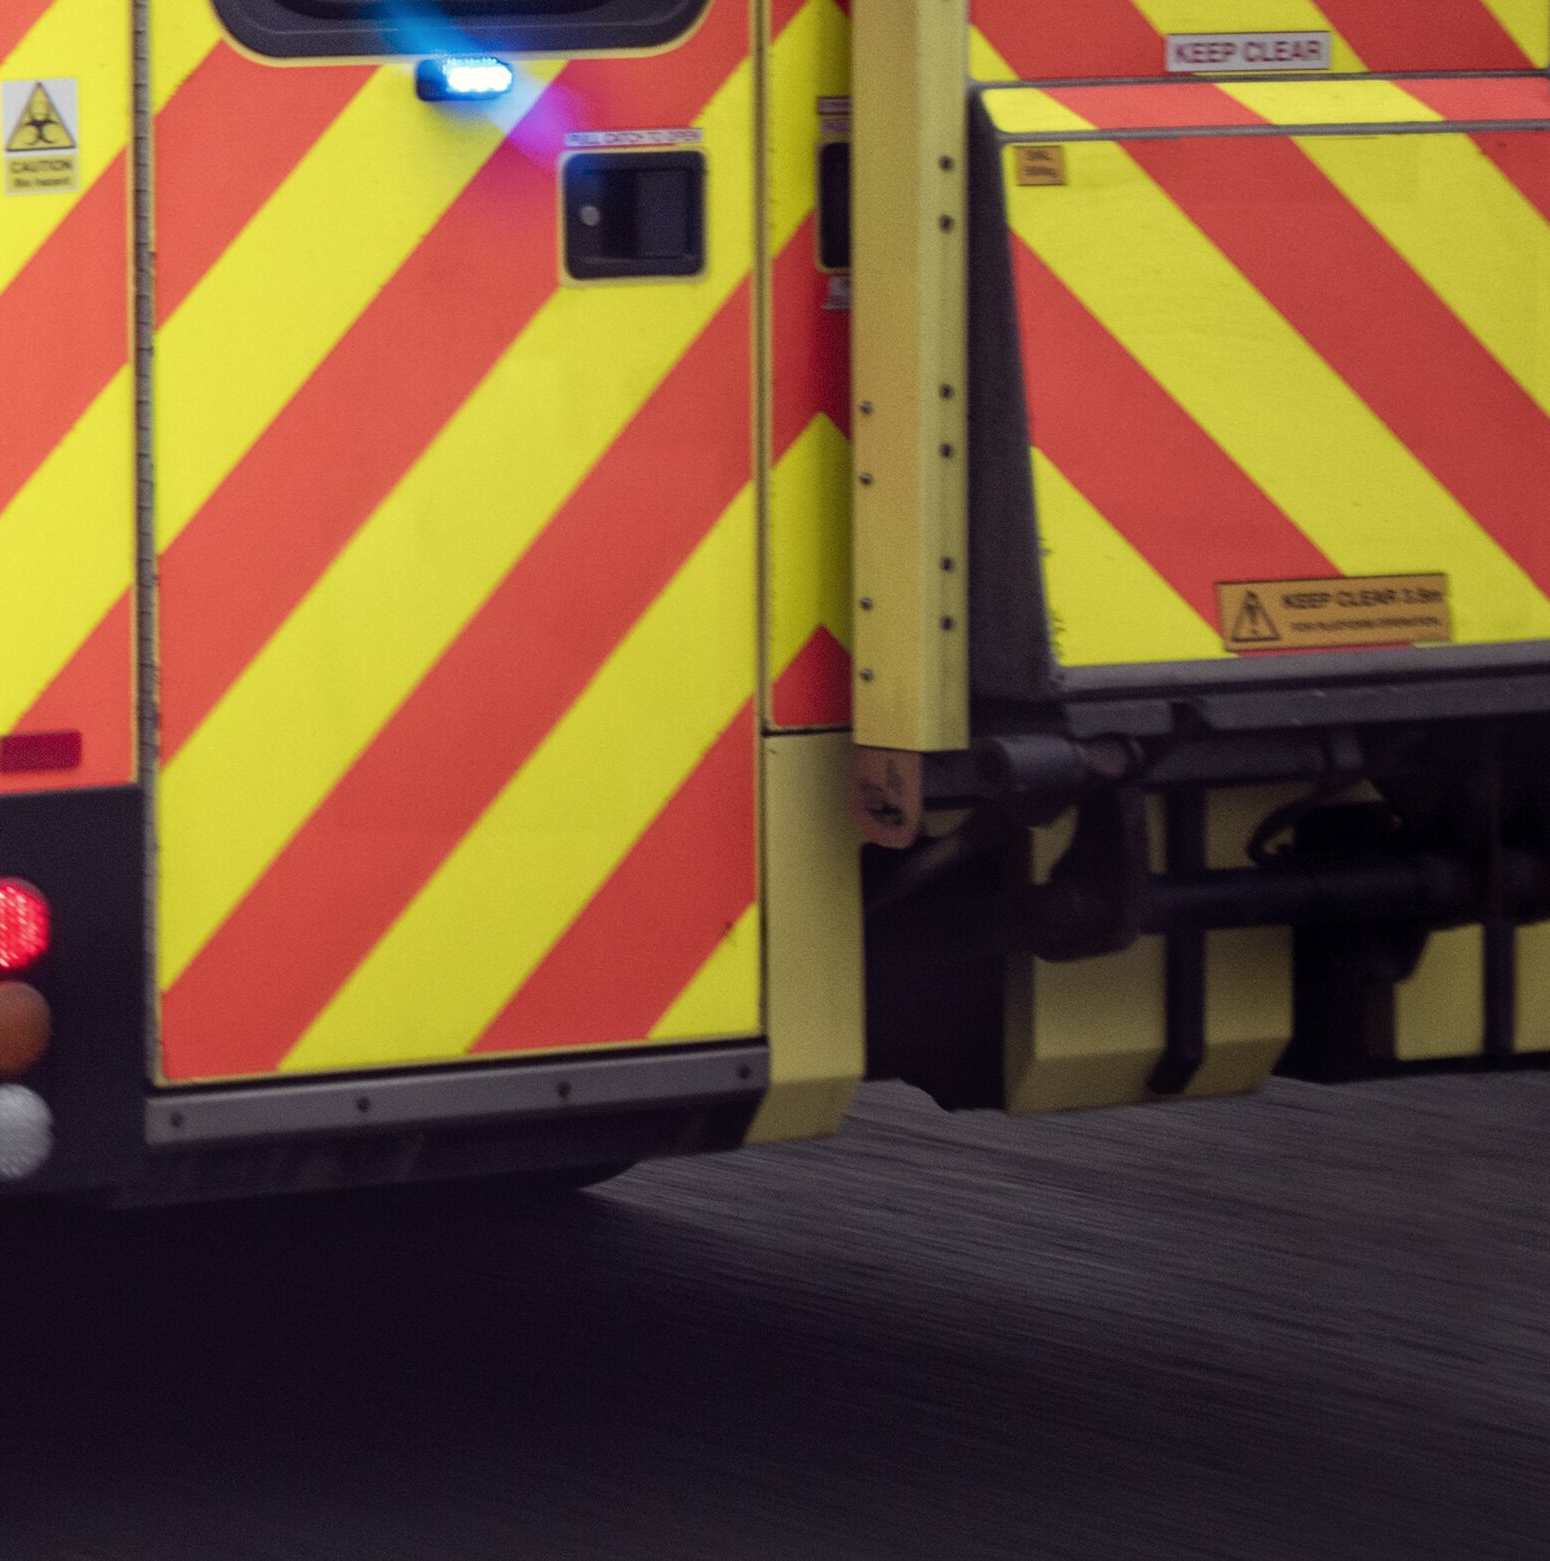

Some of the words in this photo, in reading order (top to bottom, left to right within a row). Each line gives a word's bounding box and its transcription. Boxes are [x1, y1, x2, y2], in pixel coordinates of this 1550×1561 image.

[1176, 42, 1236, 63] KEEP
[1243, 40, 1322, 62] CLEAR
[11, 160, 71, 174] CAUTION
[1282, 592, 1331, 610] KEEP
[1336, 589, 1397, 608] CLEAR
